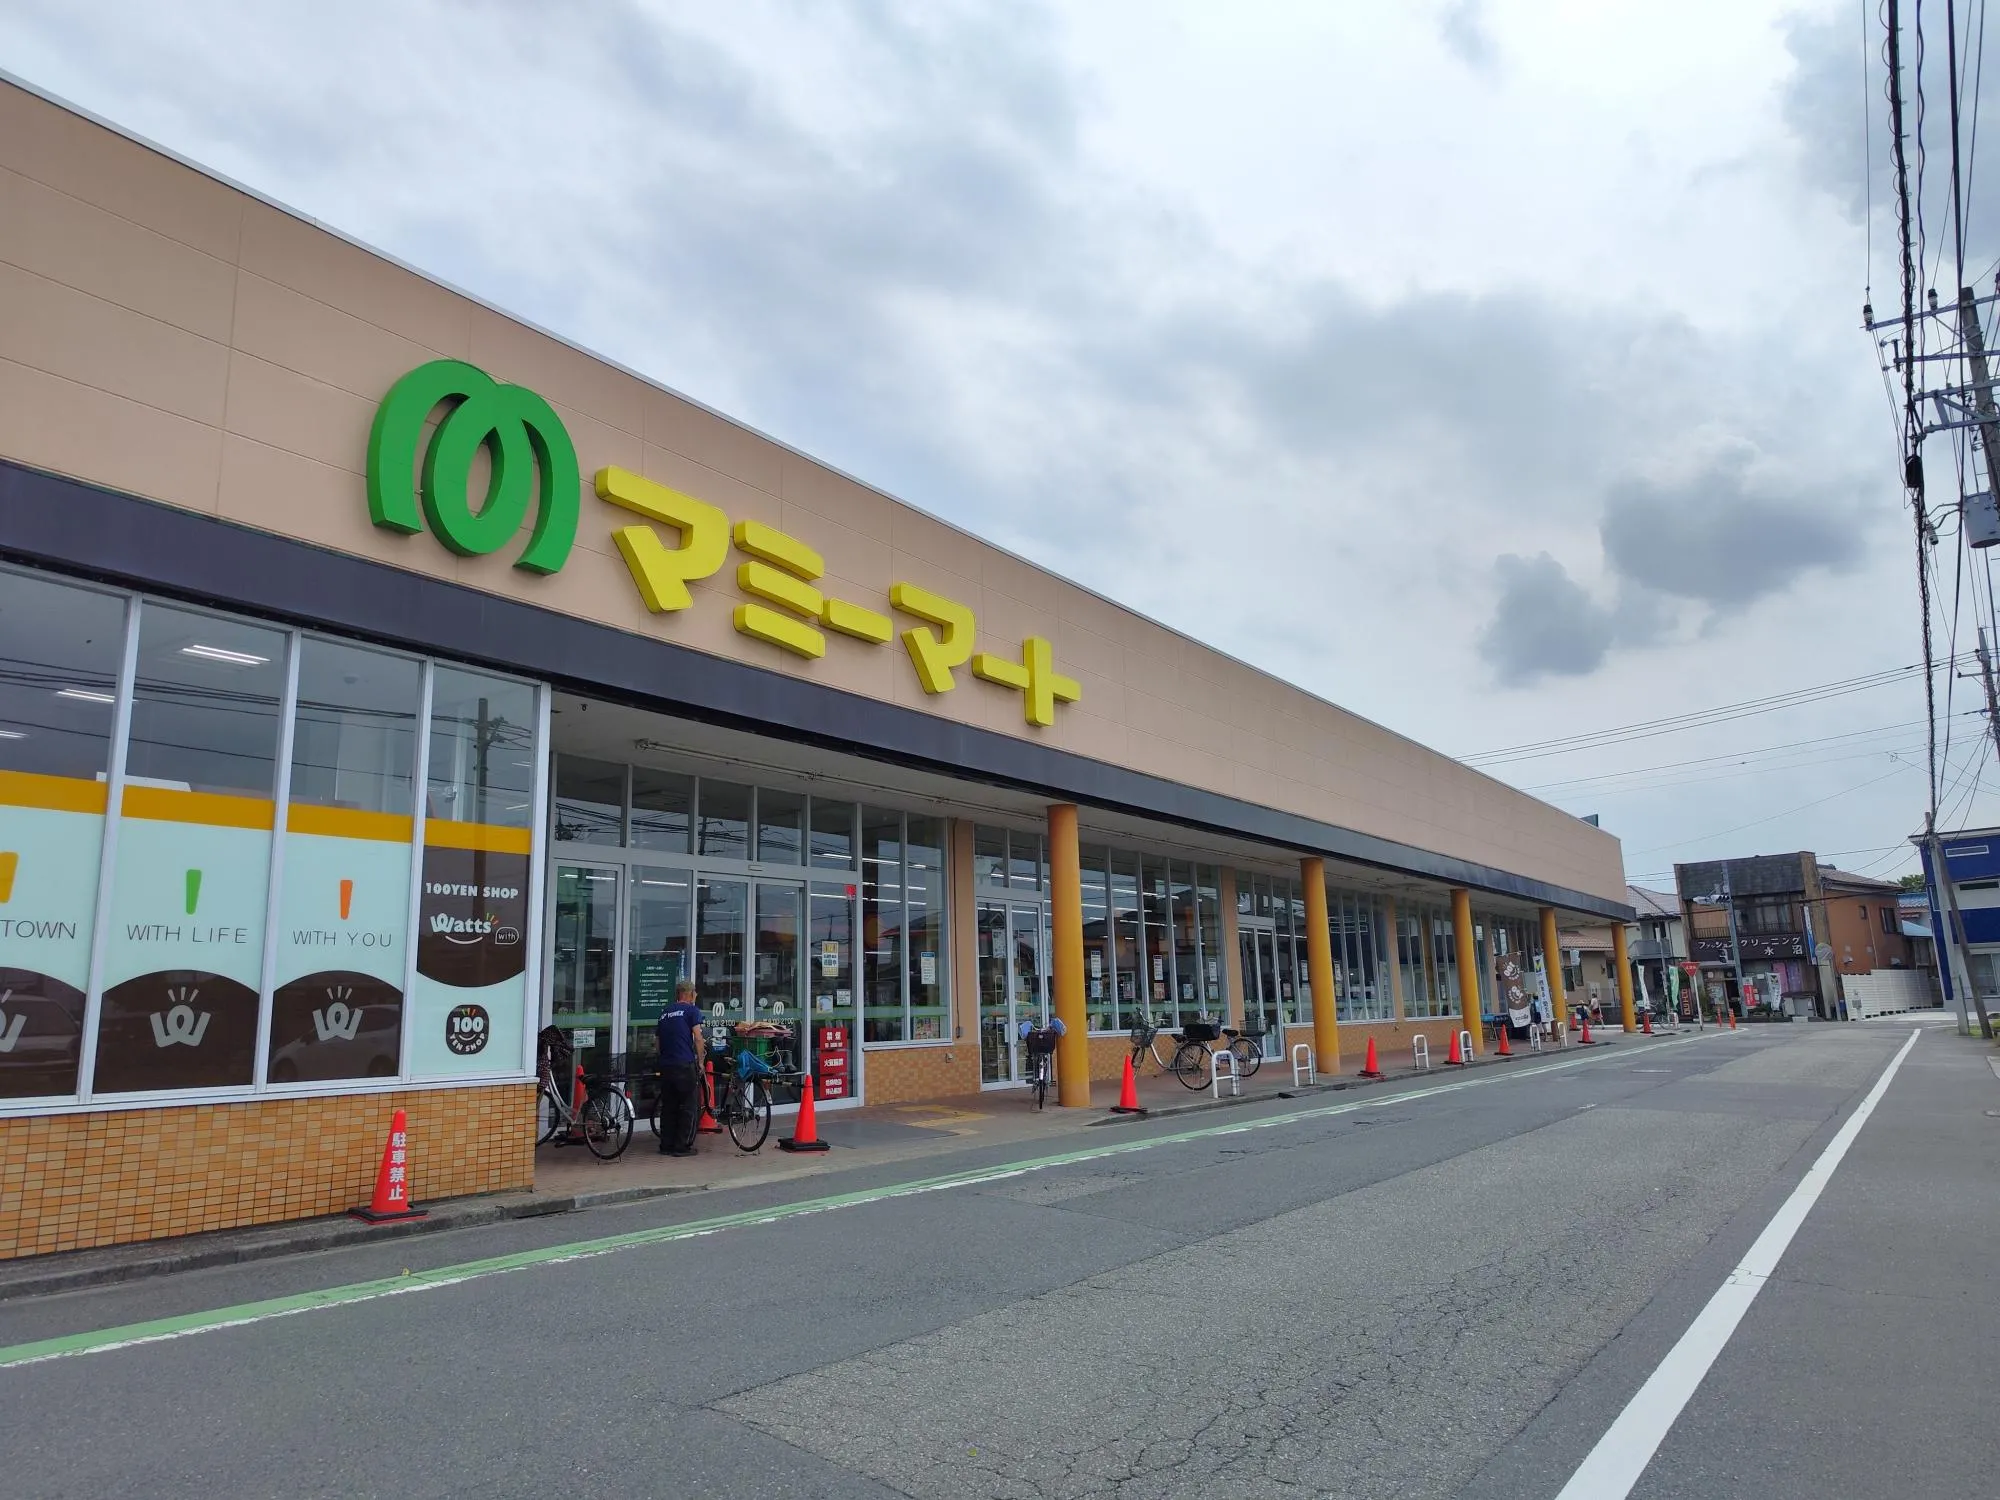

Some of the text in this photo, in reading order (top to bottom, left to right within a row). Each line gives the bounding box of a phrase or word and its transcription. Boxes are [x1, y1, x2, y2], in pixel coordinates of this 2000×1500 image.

[425, 882, 519, 899] 100YEN SHOP
[0, 919, 77, 940] TOWN
[430, 912, 492, 934] Watts
[126, 924, 249, 944] WITH LIFE
[292, 930, 392, 948] WITH YOU
[498, 932, 516, 941] with
[452, 1016, 484, 1033] 100
[449, 1033, 486, 1052] YEN SHOP
[388, 1131, 406, 1201] 駐車禁止
